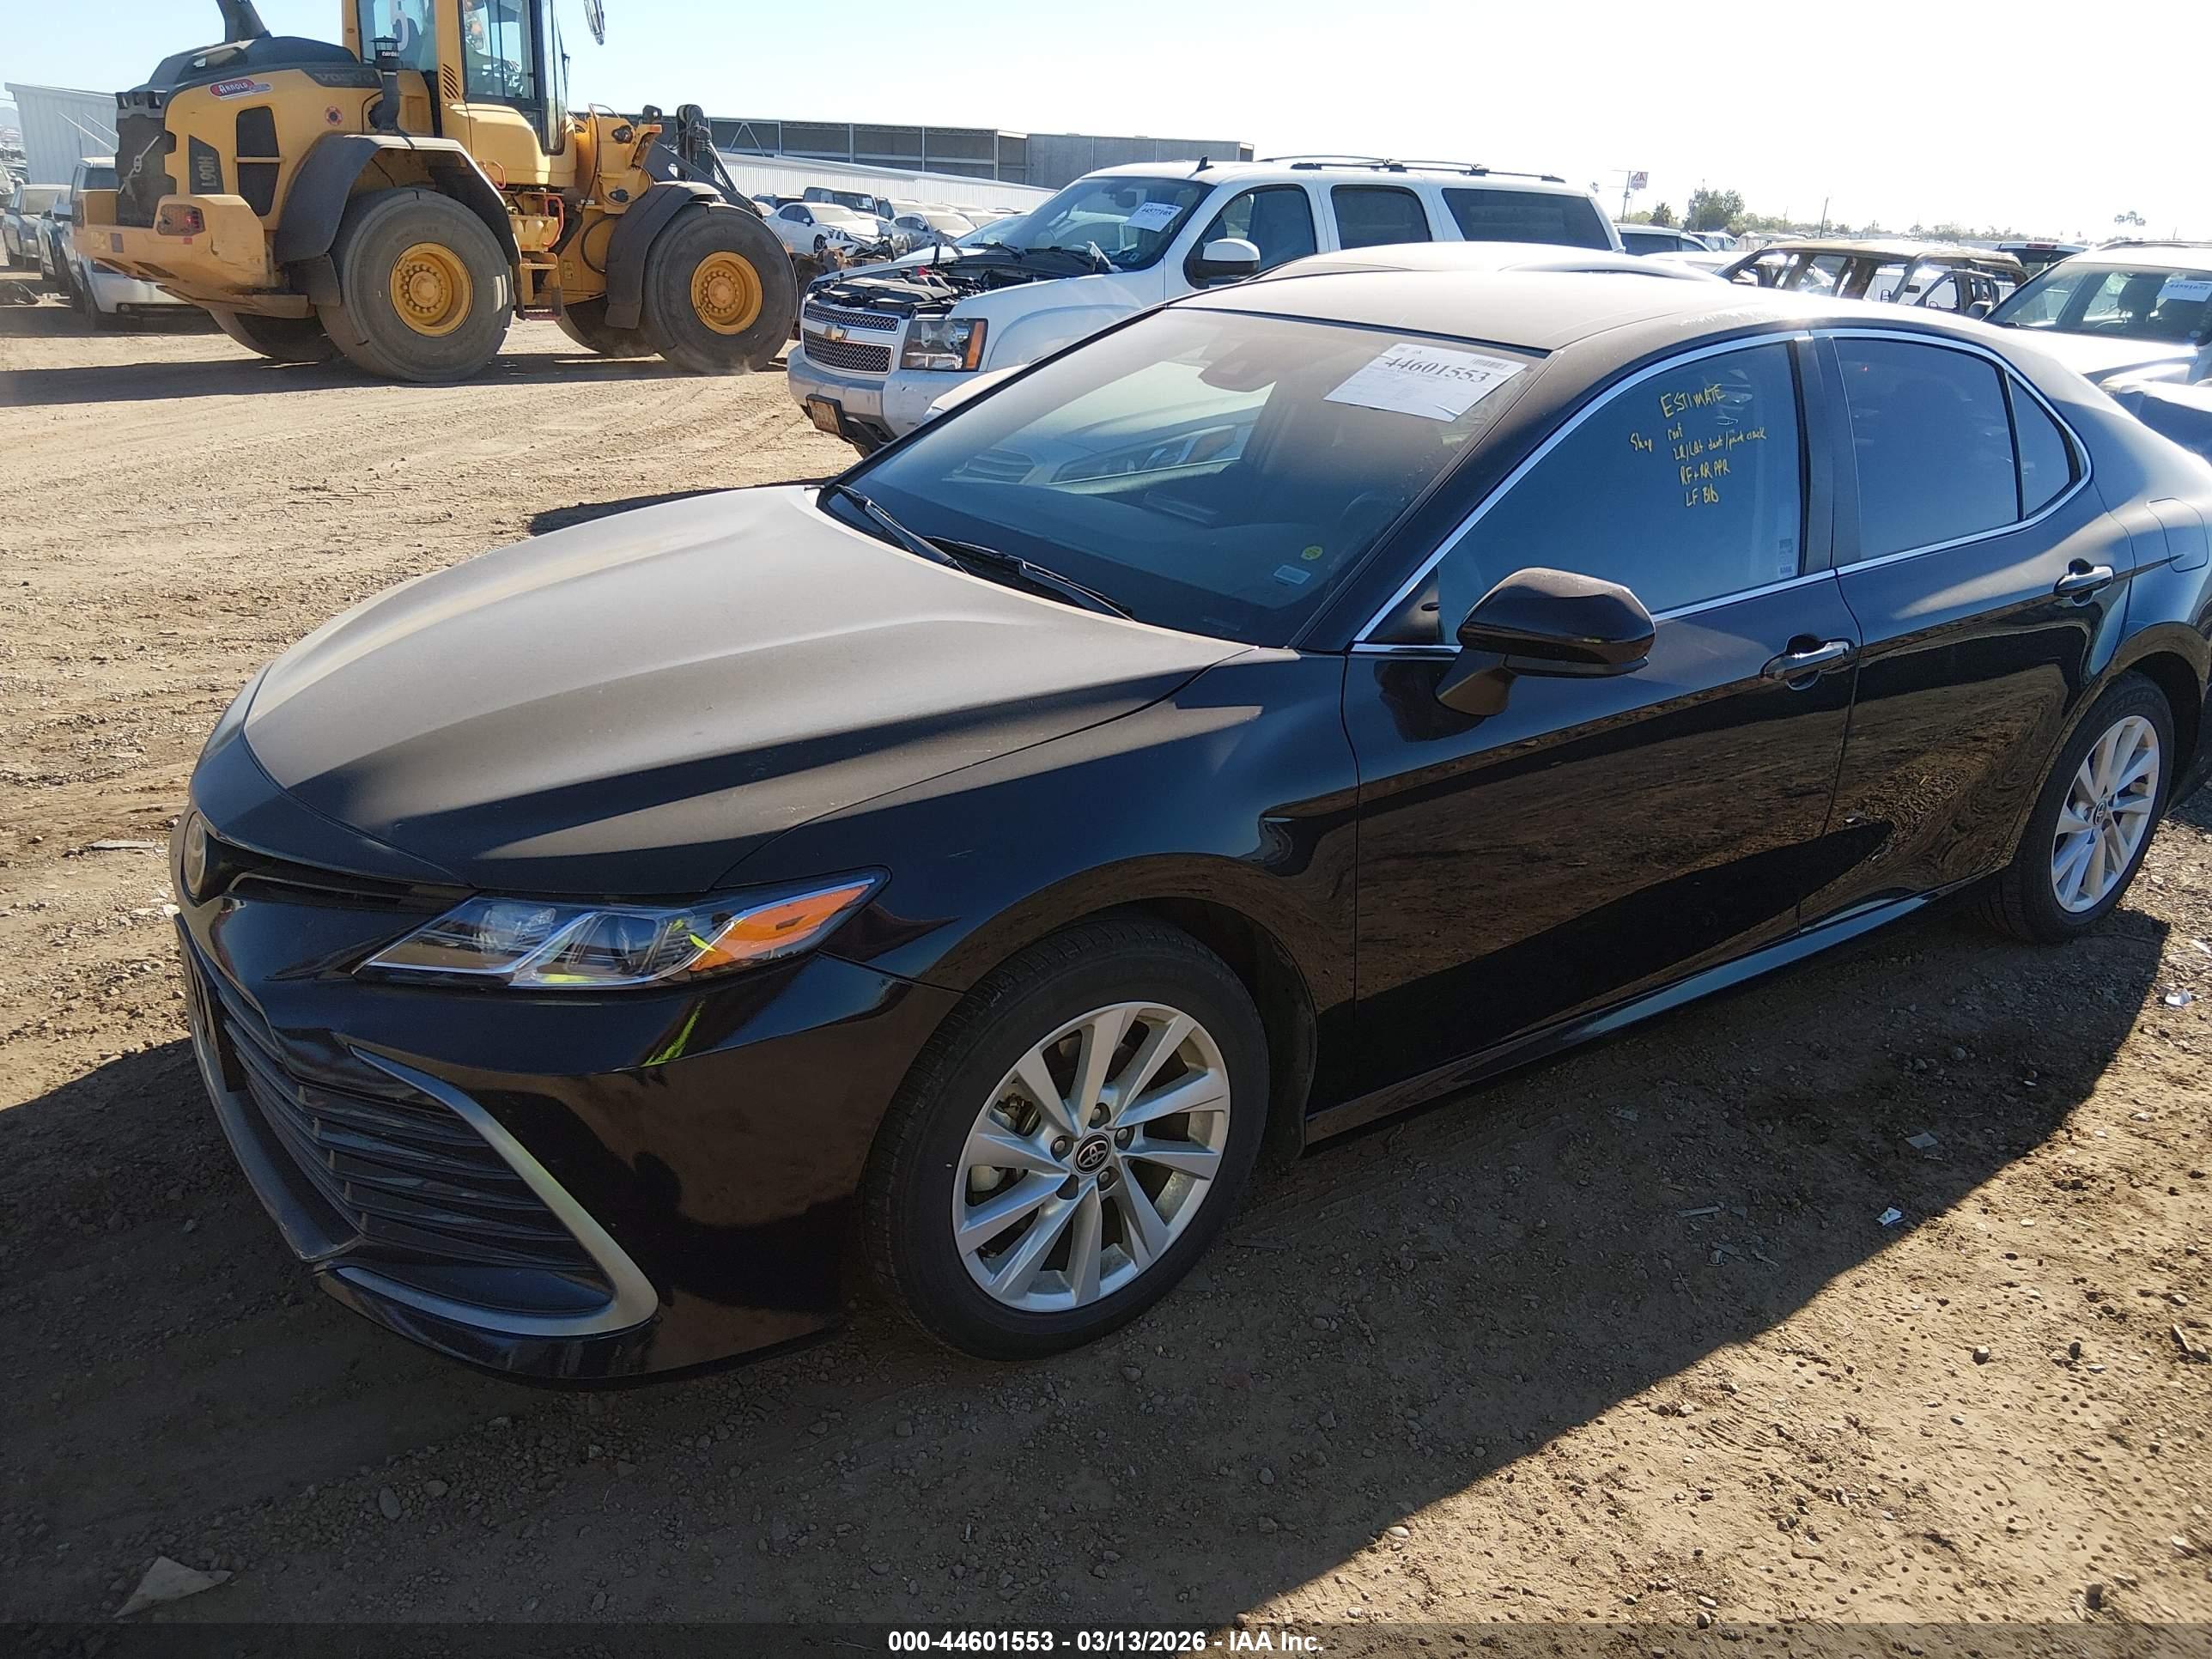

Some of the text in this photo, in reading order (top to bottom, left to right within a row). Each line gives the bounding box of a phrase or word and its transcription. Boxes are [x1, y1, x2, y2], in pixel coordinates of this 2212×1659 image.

[198, 156, 217, 186] L90H
[1384, 356, 1492, 383] 44601553
[1660, 383, 1727, 418] ESTIMATE
[1686, 487, 1698, 507] LF
